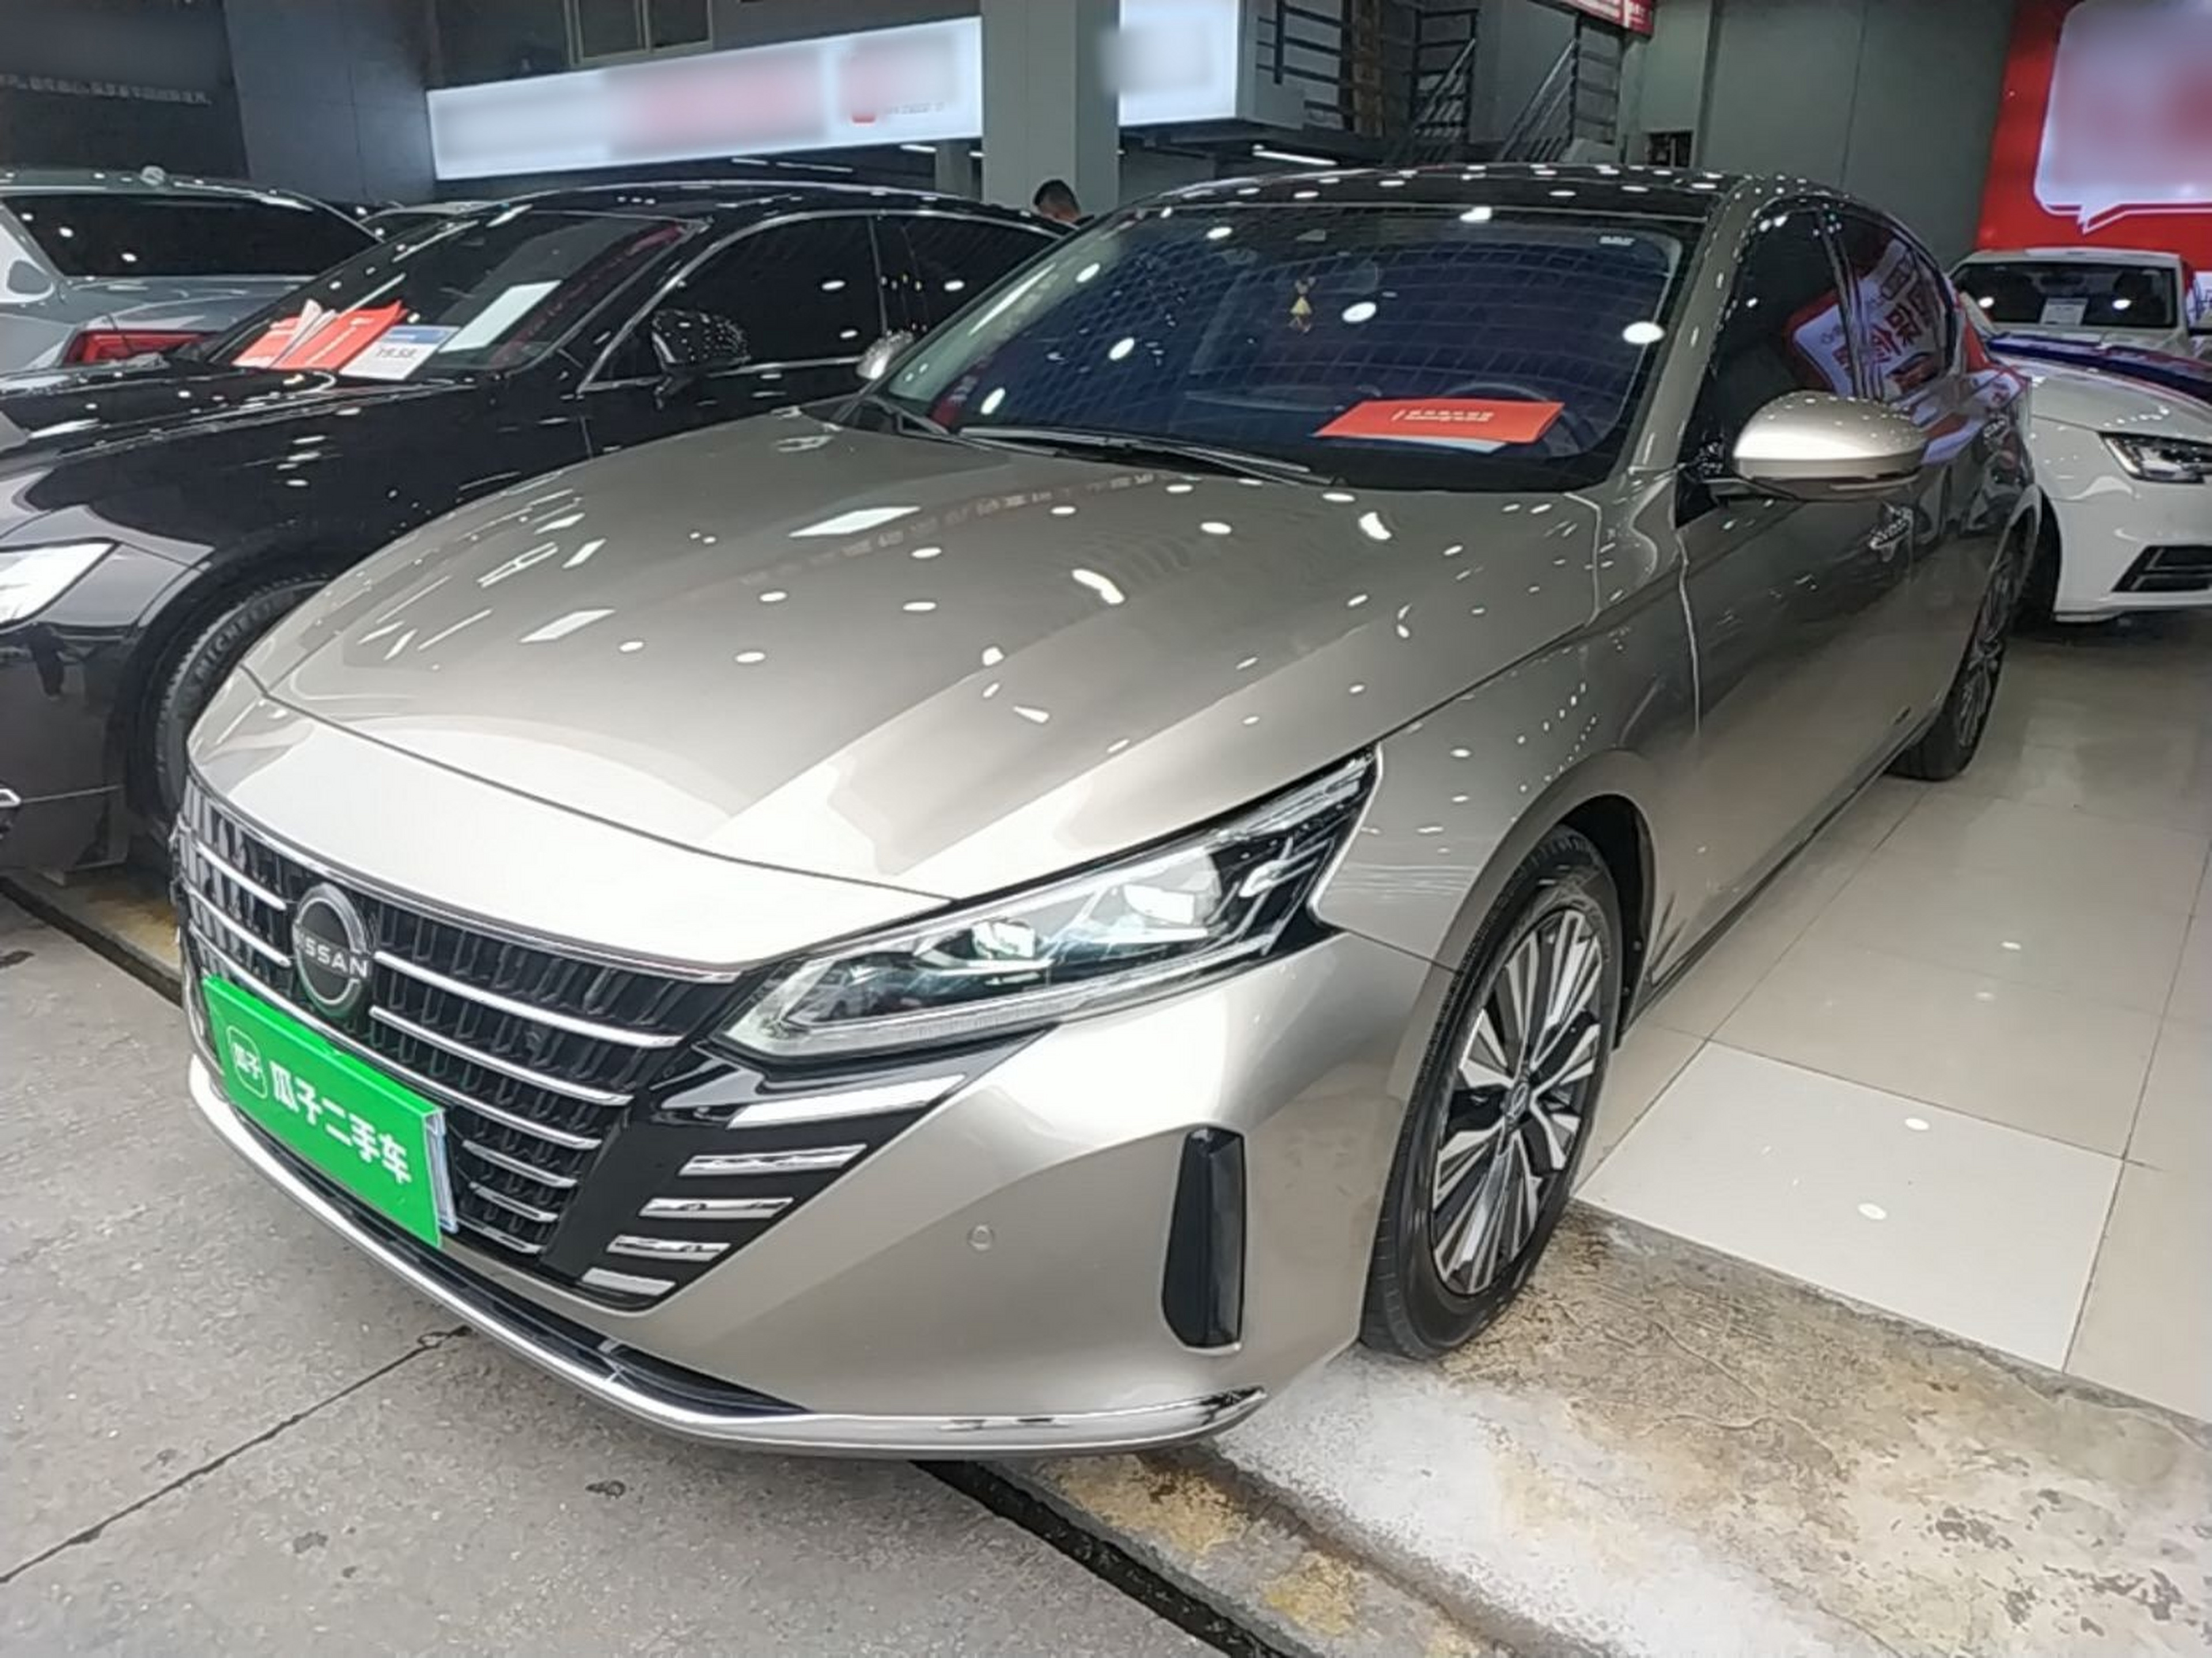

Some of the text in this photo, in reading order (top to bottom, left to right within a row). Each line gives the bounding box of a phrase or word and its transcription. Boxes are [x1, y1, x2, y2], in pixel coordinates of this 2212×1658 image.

[292, 925, 369, 978] SSAN
[269, 1058, 412, 1184] 瓜子二手车
